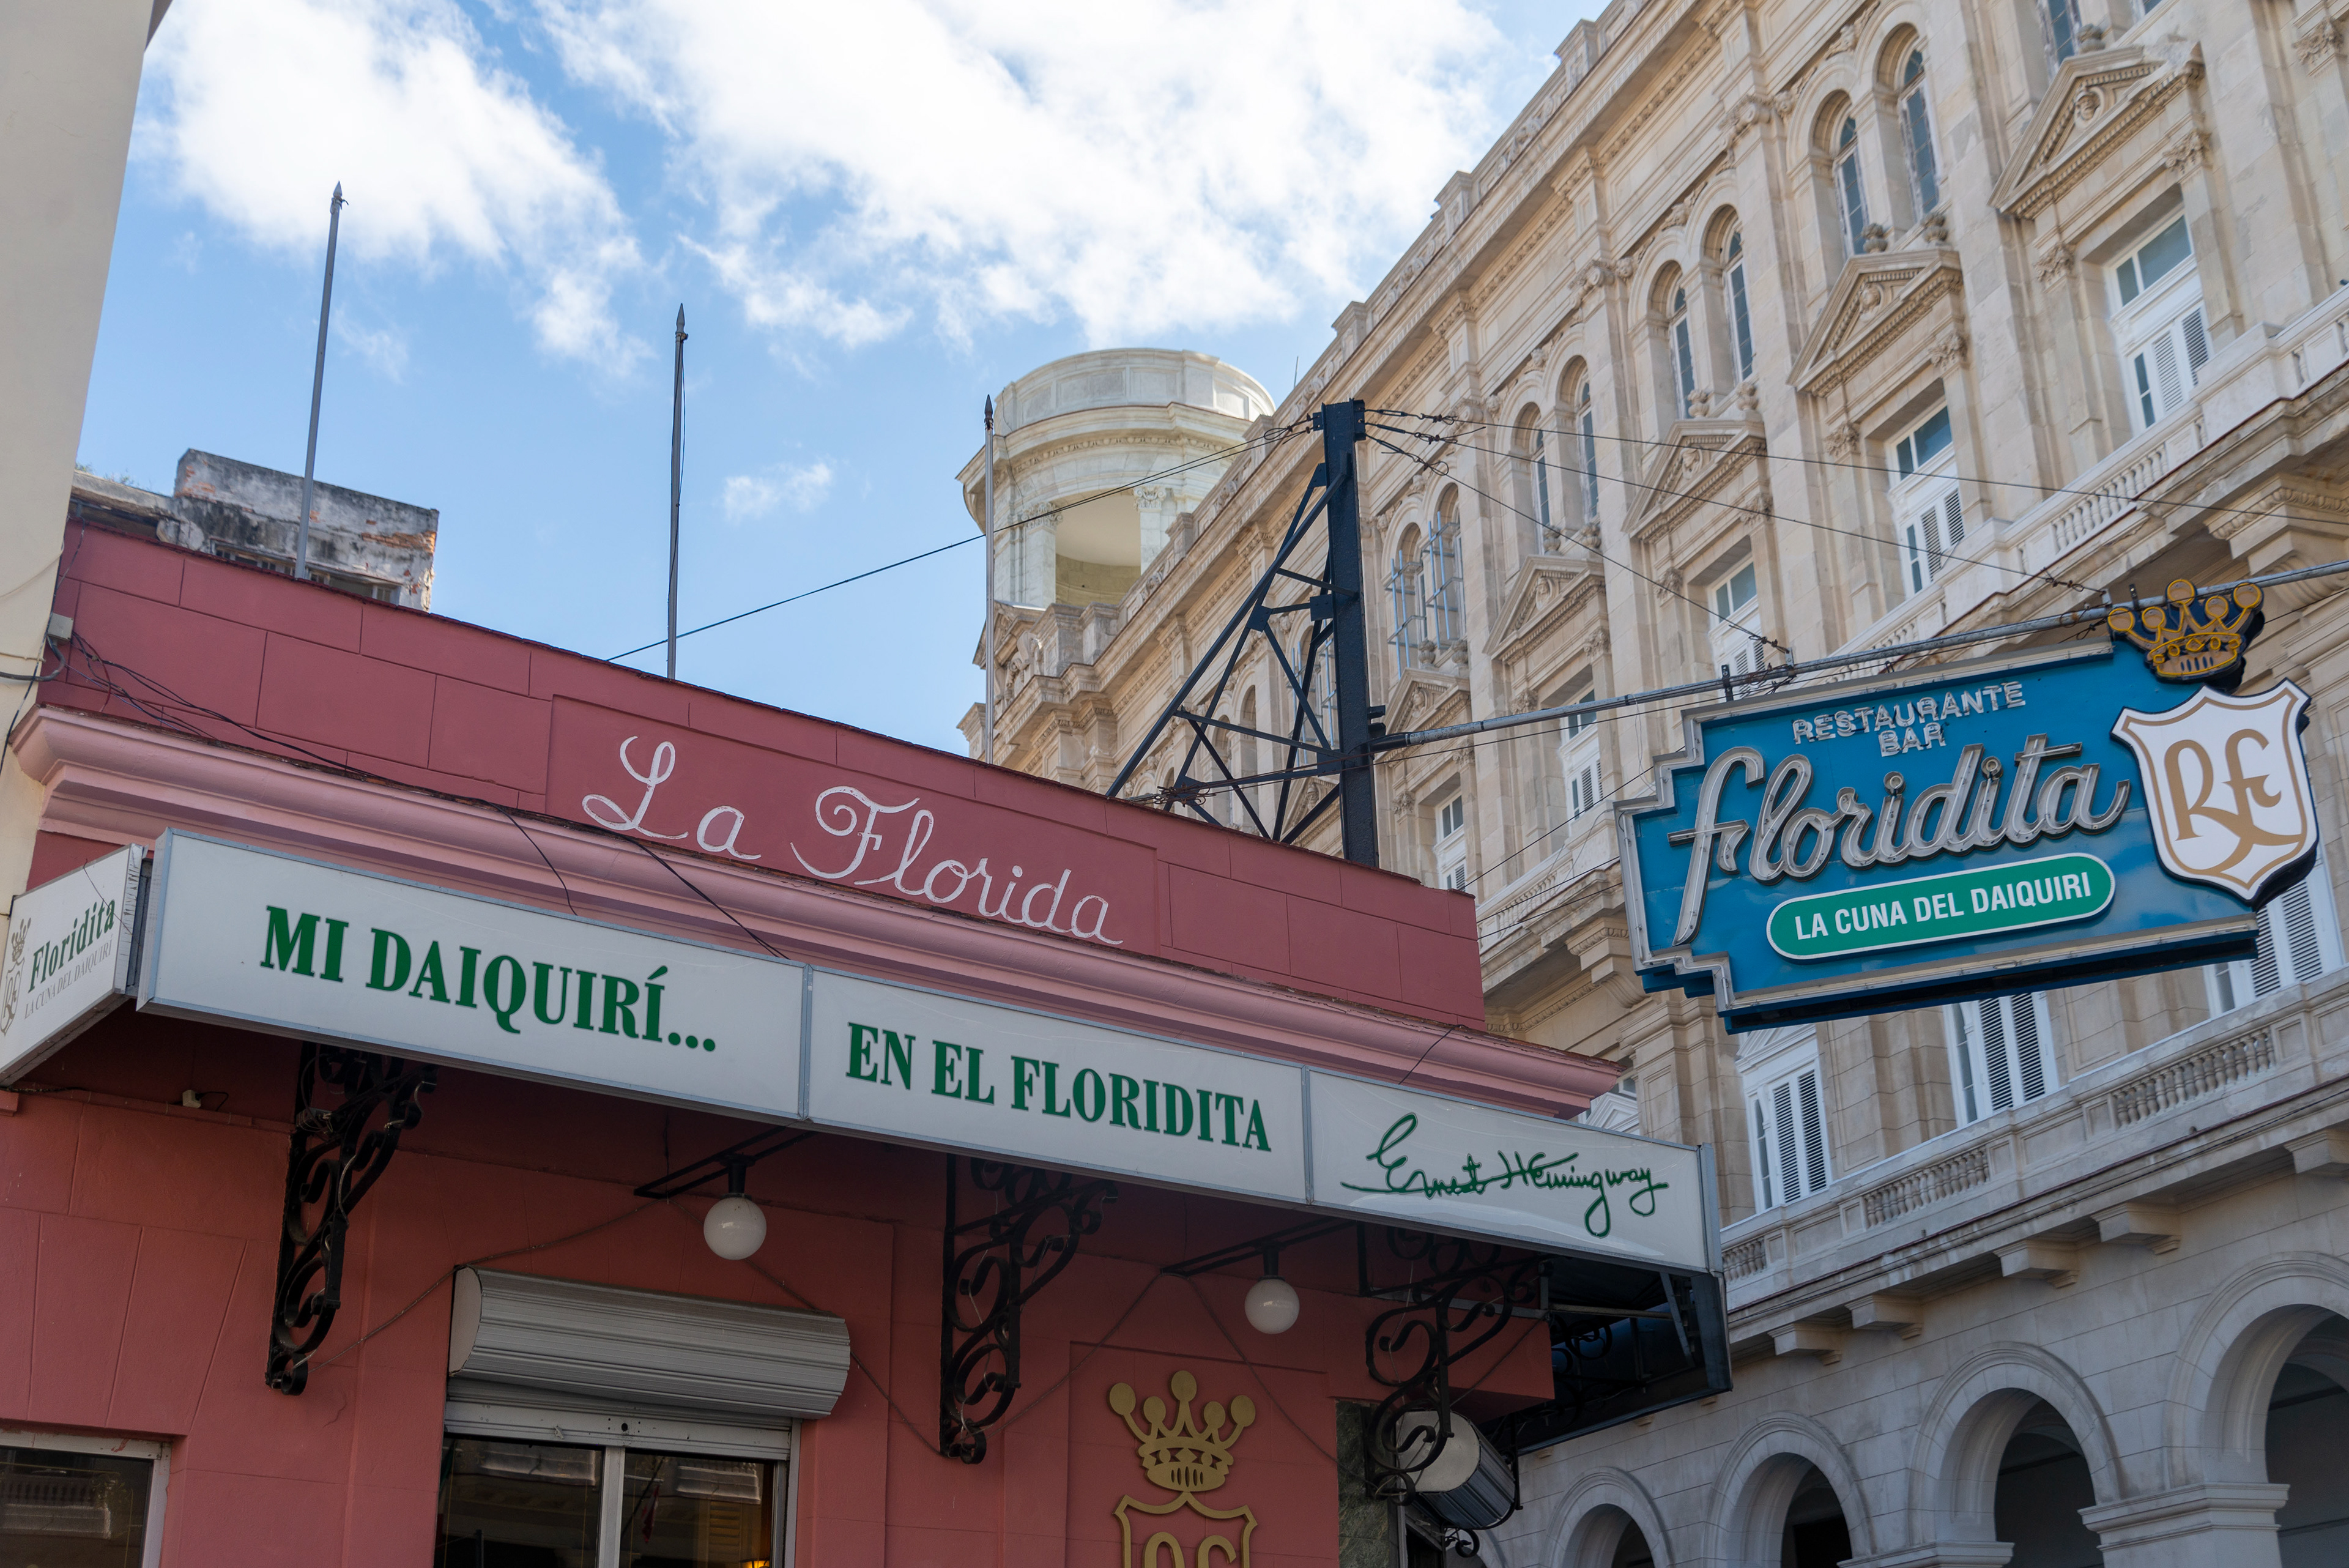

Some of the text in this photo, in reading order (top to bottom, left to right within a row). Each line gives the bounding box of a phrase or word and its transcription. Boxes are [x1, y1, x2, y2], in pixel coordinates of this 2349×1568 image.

[1792, 681, 2026, 745] RESTAURANTE
[1878, 722, 1946, 757] BAR
[582, 736, 1124, 944] La Florida
[28, 899, 115, 994] Floridita
[1795, 872, 2091, 940] LA CUNA DEL DAIQUIRI
[24, 934, 113, 1019] LA CUNA DEL DAIQUIRÍ
[260, 905, 716, 1052] MI DAIQUIRÍ...
[846, 1022, 1272, 1152] EN EL FLORIDITA
[1496, 1151, 1669, 1238] Hemingway
